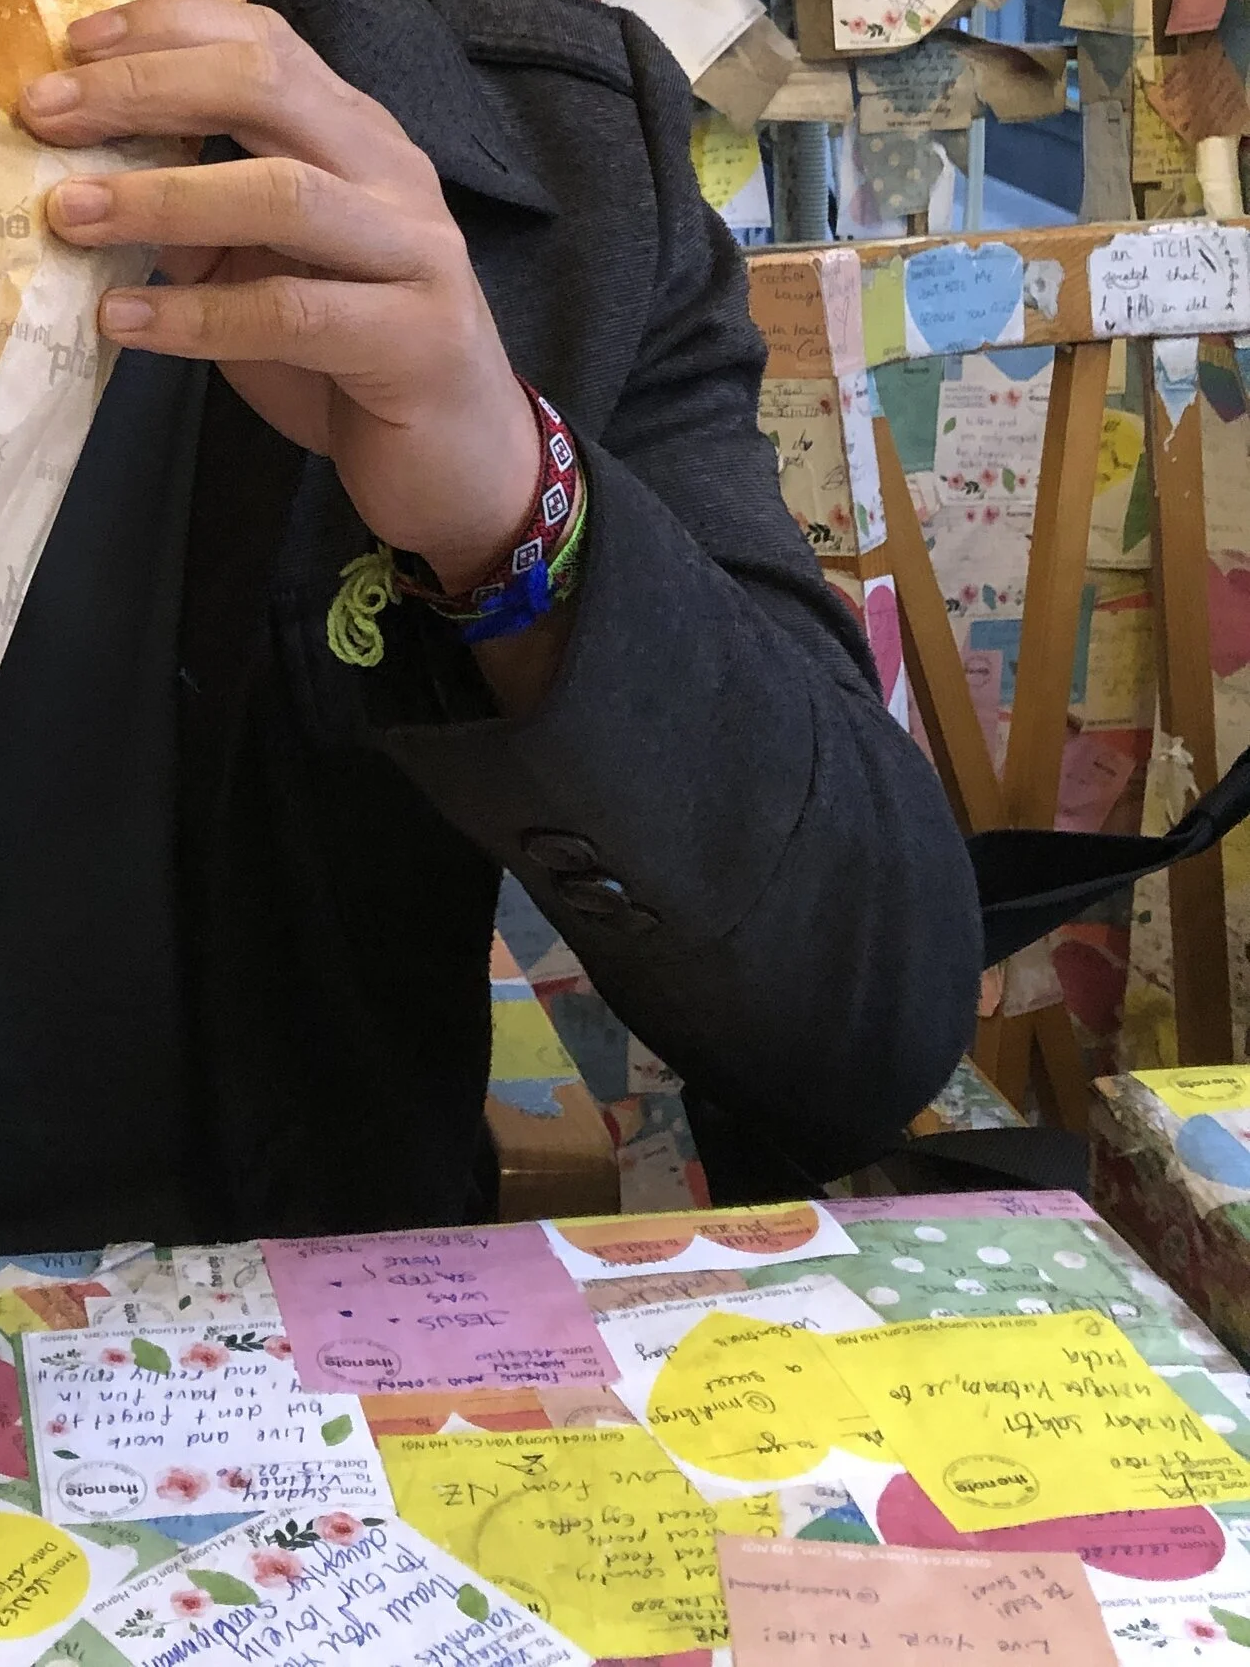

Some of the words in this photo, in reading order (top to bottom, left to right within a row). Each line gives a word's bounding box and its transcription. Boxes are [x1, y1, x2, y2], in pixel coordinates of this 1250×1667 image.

[1152, 237, 1191, 258] ITCH
[635, 1343, 678, 1363] day
[225, 1365, 266, 1380] and
[57, 1390, 81, 1403] in
[100, 1389, 144, 1408] fun
[165, 1389, 216, 1402] have
[286, 1402, 322, 1416] but
[56, 1414, 83, 1429] to
[96, 1408, 169, 1429] forget
[107, 1435, 164, 1448] work
[187, 1433, 228, 1446] and
[335, 1460, 367, 1470] Date
[242, 1484, 329, 1503] Sydney
[340, 1487, 376, 1497] From
[601, 1511, 634, 1529] Egg
[31, 1542, 57, 1564] Date
[47, 1552, 77, 1576] From
[284, 1529, 386, 1600] daughter
